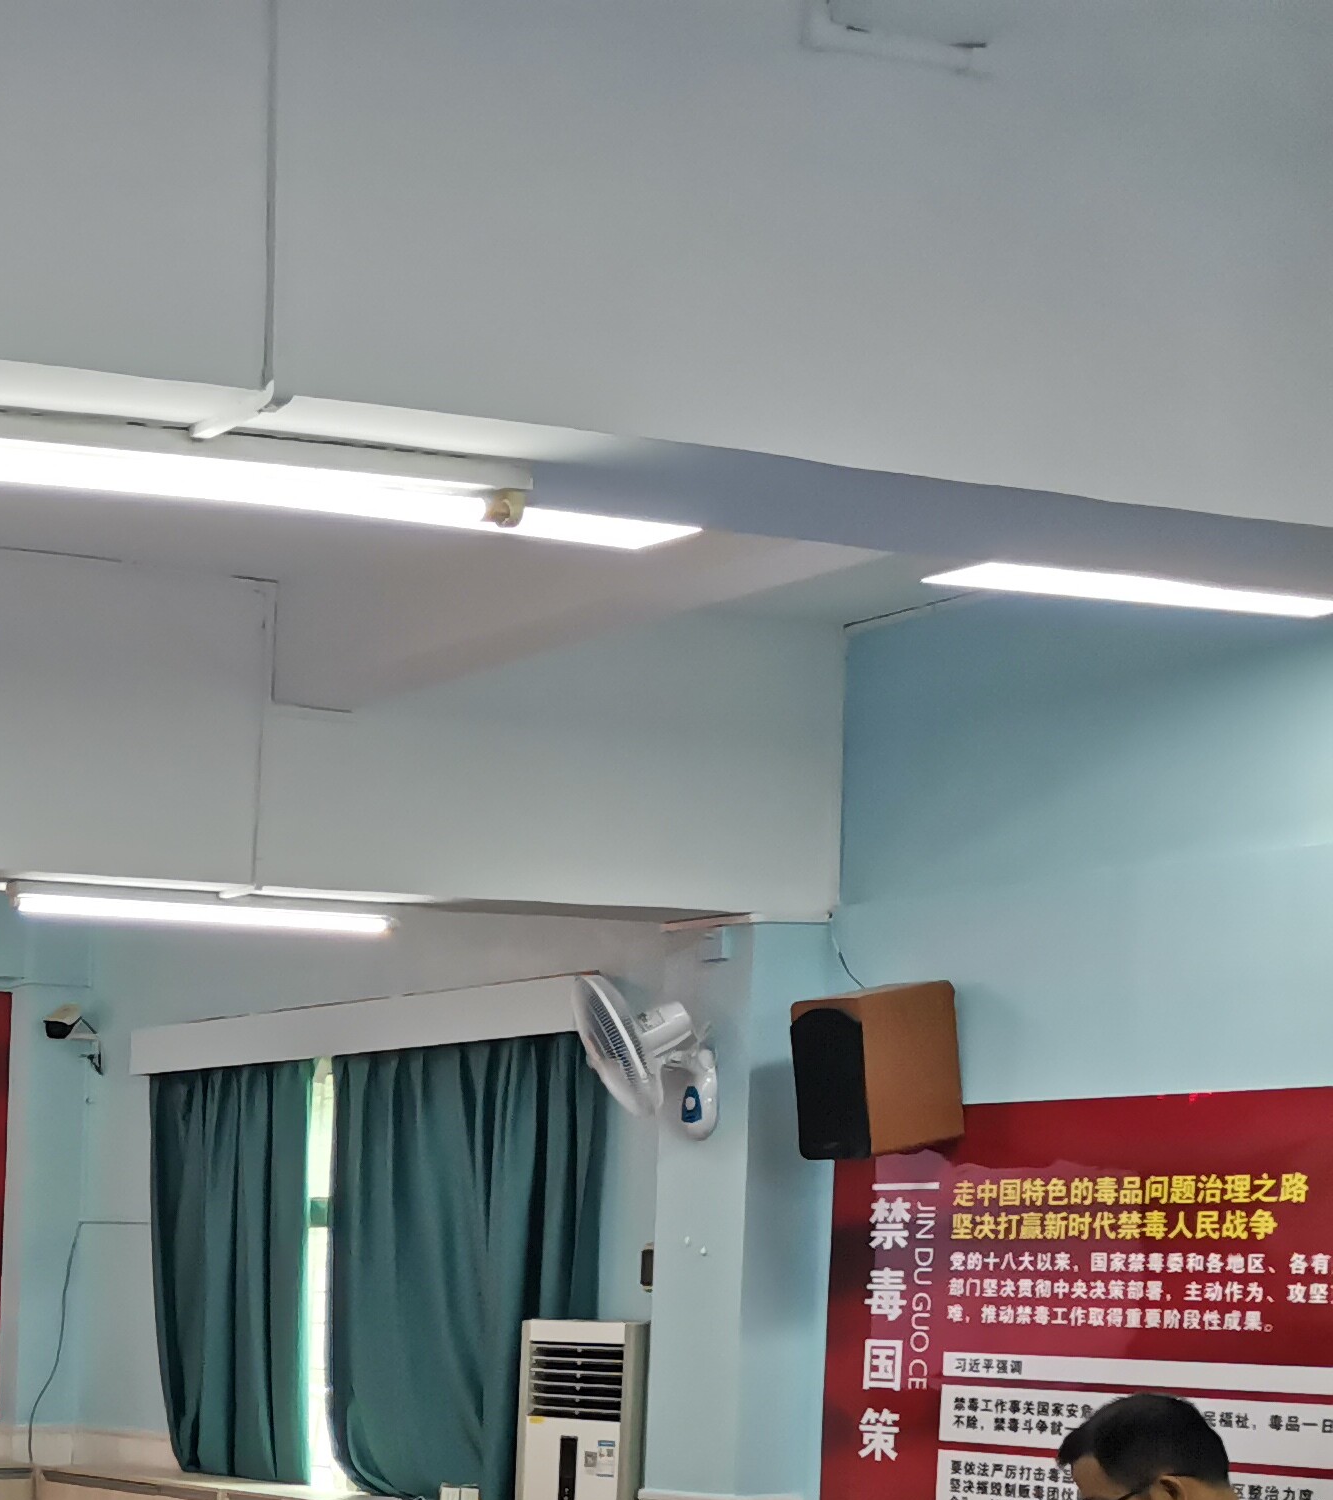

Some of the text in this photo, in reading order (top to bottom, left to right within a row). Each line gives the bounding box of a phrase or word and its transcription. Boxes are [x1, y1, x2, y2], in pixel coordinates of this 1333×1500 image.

[953, 1172, 1309, 1206] 走中国特色的毒品问题治理之路
[950, 1210, 1278, 1241] 坚决打赢新时代禁毒人民战争
[949, 1251, 1333, 1276] 党的十八大以来，国家禁毒委和各地区、各有
[908, 1201, 936, 1390] JIN DU GUO CE
[948, 1278, 1333, 1304] 部门坚决贯彻中央决策部署，主动作为、攻坚
[858, 1197, 911, 1461] 禁毒国策
[954, 1357, 1023, 1375] 习近平强调
